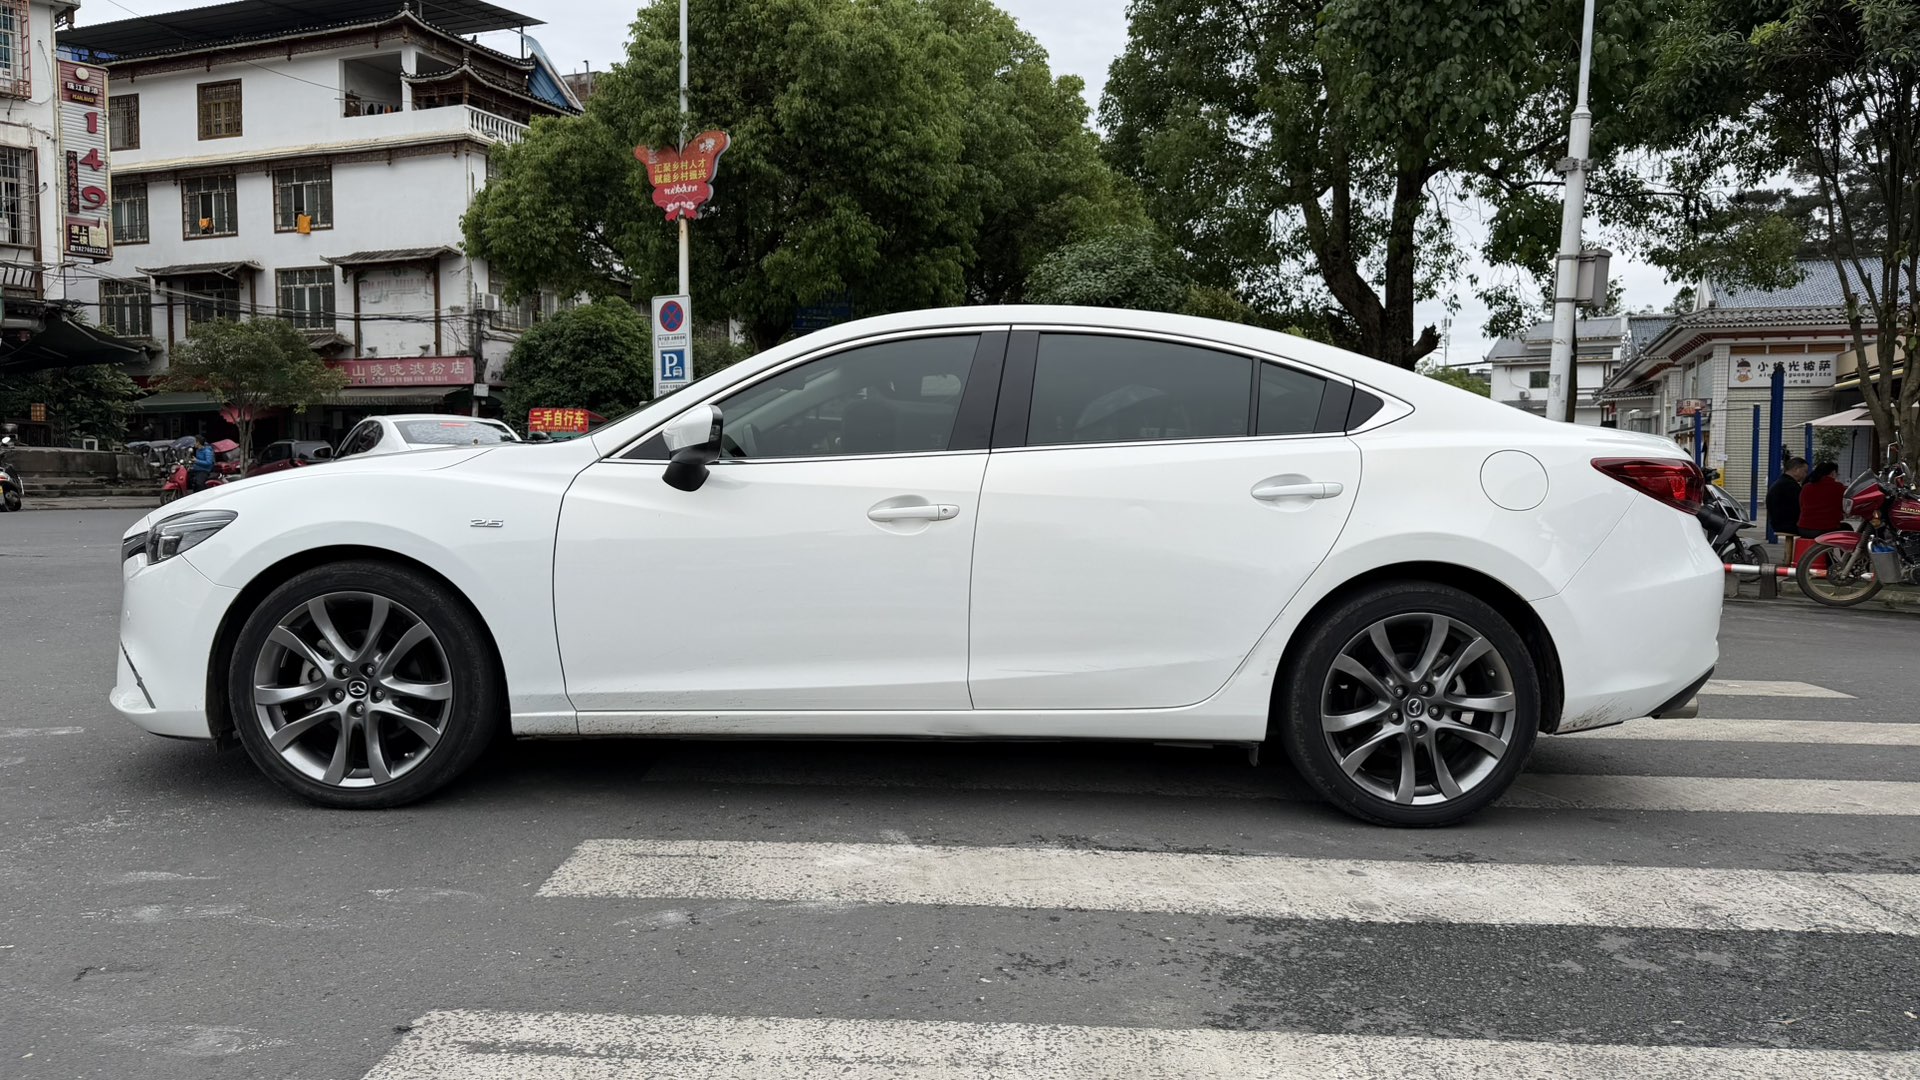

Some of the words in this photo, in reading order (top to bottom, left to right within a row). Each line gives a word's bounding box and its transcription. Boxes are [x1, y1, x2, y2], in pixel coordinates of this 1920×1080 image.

[655, 158, 706, 174] 汇聚乡村人才
[655, 169, 707, 184] 赋能乡村振兴
[662, 353, 678, 377] P
[533, 410, 584, 426] 二手自行车
